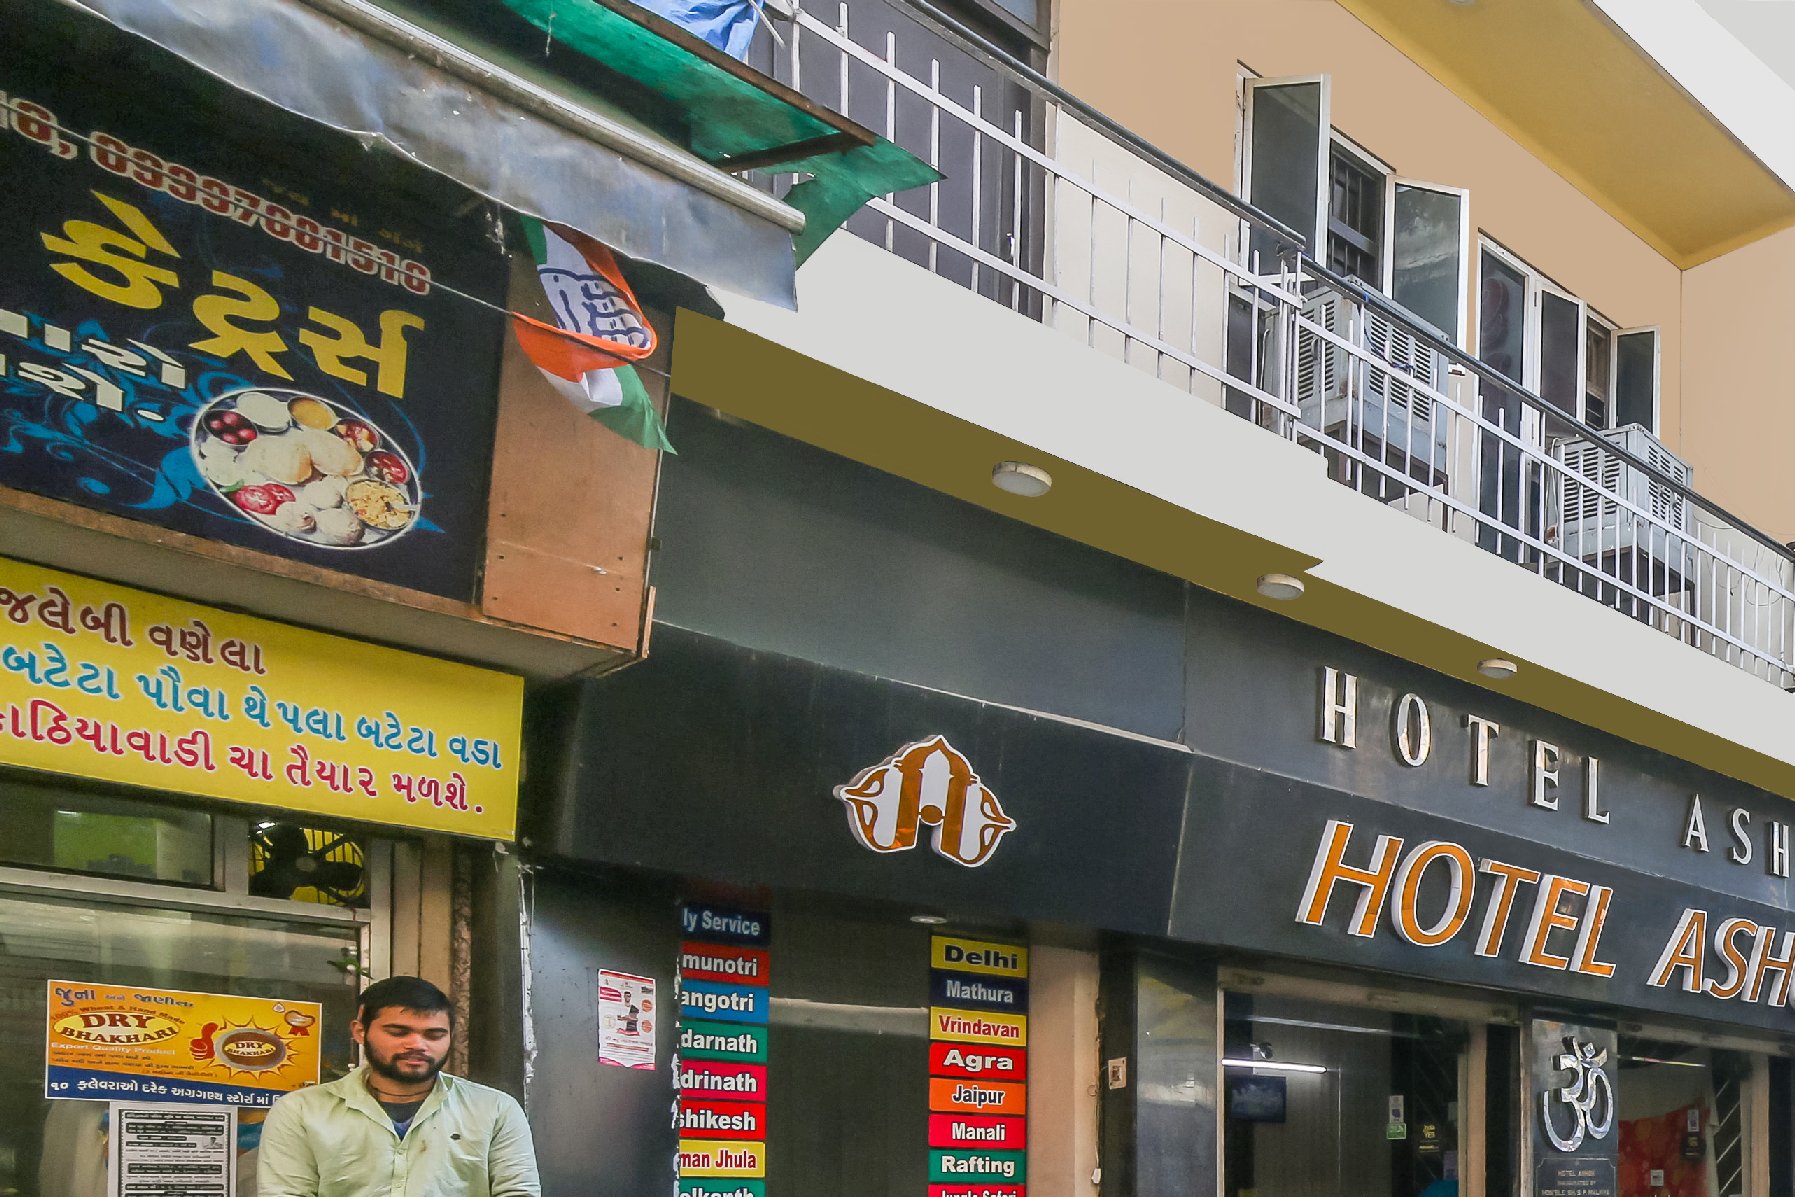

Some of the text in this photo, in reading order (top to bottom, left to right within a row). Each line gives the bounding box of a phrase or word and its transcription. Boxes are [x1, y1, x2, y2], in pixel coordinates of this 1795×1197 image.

[0, 587, 266, 675] જલેબી વણેલા
[3, 643, 120, 698] બટેટા
[136, 665, 230, 720] પૌવા
[357, 712, 437, 757] બટેટા
[449, 736, 501, 769] વડા
[0, 699, 215, 771] ાઠિયાવાડી
[286, 744, 377, 797] તૈયાર
[1319, 665, 1611, 825] HOTEL
[1295, 820, 1617, 978] HOTEL
[702, 911, 760, 936] Service
[682, 954, 757, 976] munotri
[943, 942, 1018, 972] Delhi
[946, 979, 1014, 1005] Mathura
[80, 1013, 156, 1029] DRY
[938, 1015, 1020, 1040] Vrindavan
[60, 1026, 179, 1044] BHAKHARI
[235, 1041, 266, 1050] DRY
[680, 1029, 757, 1053] darnath
[943, 1048, 1014, 1073] Agra
[952, 1083, 1005, 1108] Jaipur
[951, 1121, 1006, 1142] Manali
[716, 1150, 757, 1169] Jhula
[941, 1154, 1016, 1179] Rafting
